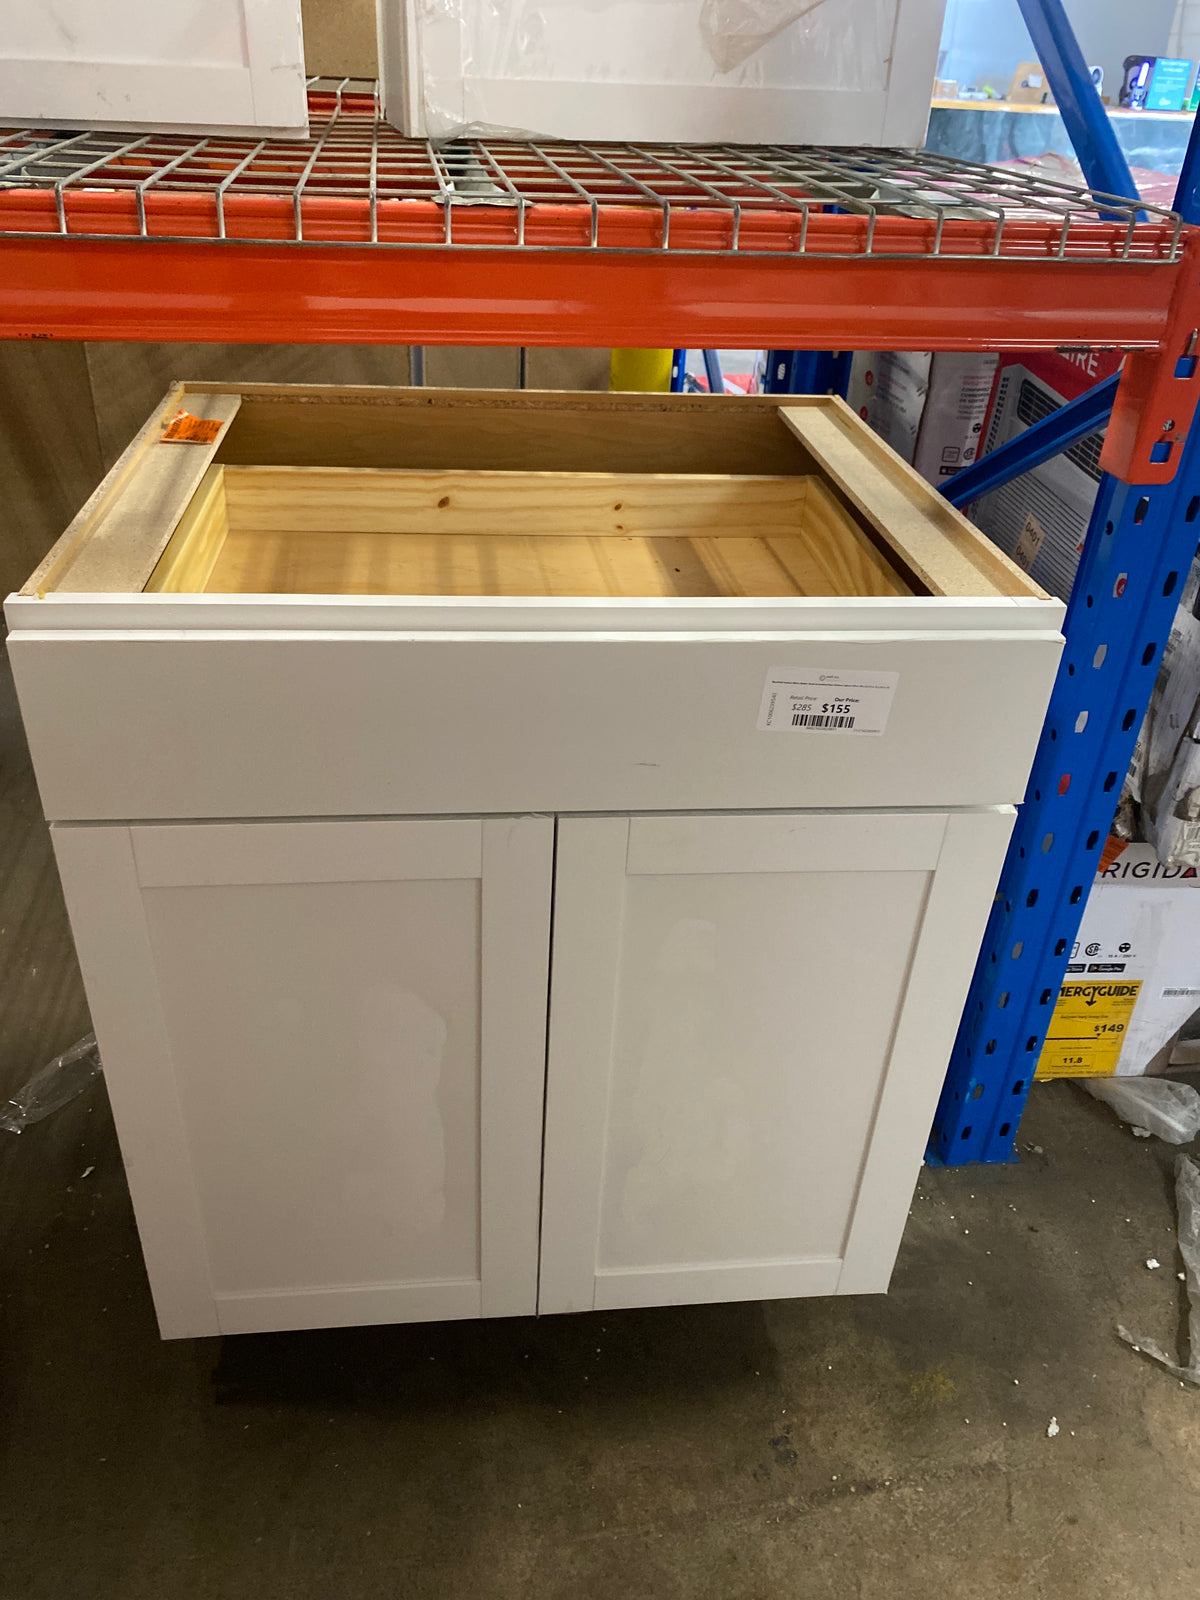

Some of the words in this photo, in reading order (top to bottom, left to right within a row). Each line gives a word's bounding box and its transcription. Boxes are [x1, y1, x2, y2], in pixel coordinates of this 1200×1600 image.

[791, 703, 812, 712] $285
[821, 703, 851, 714] $155
[1094, 1023, 1125, 1033] $149
